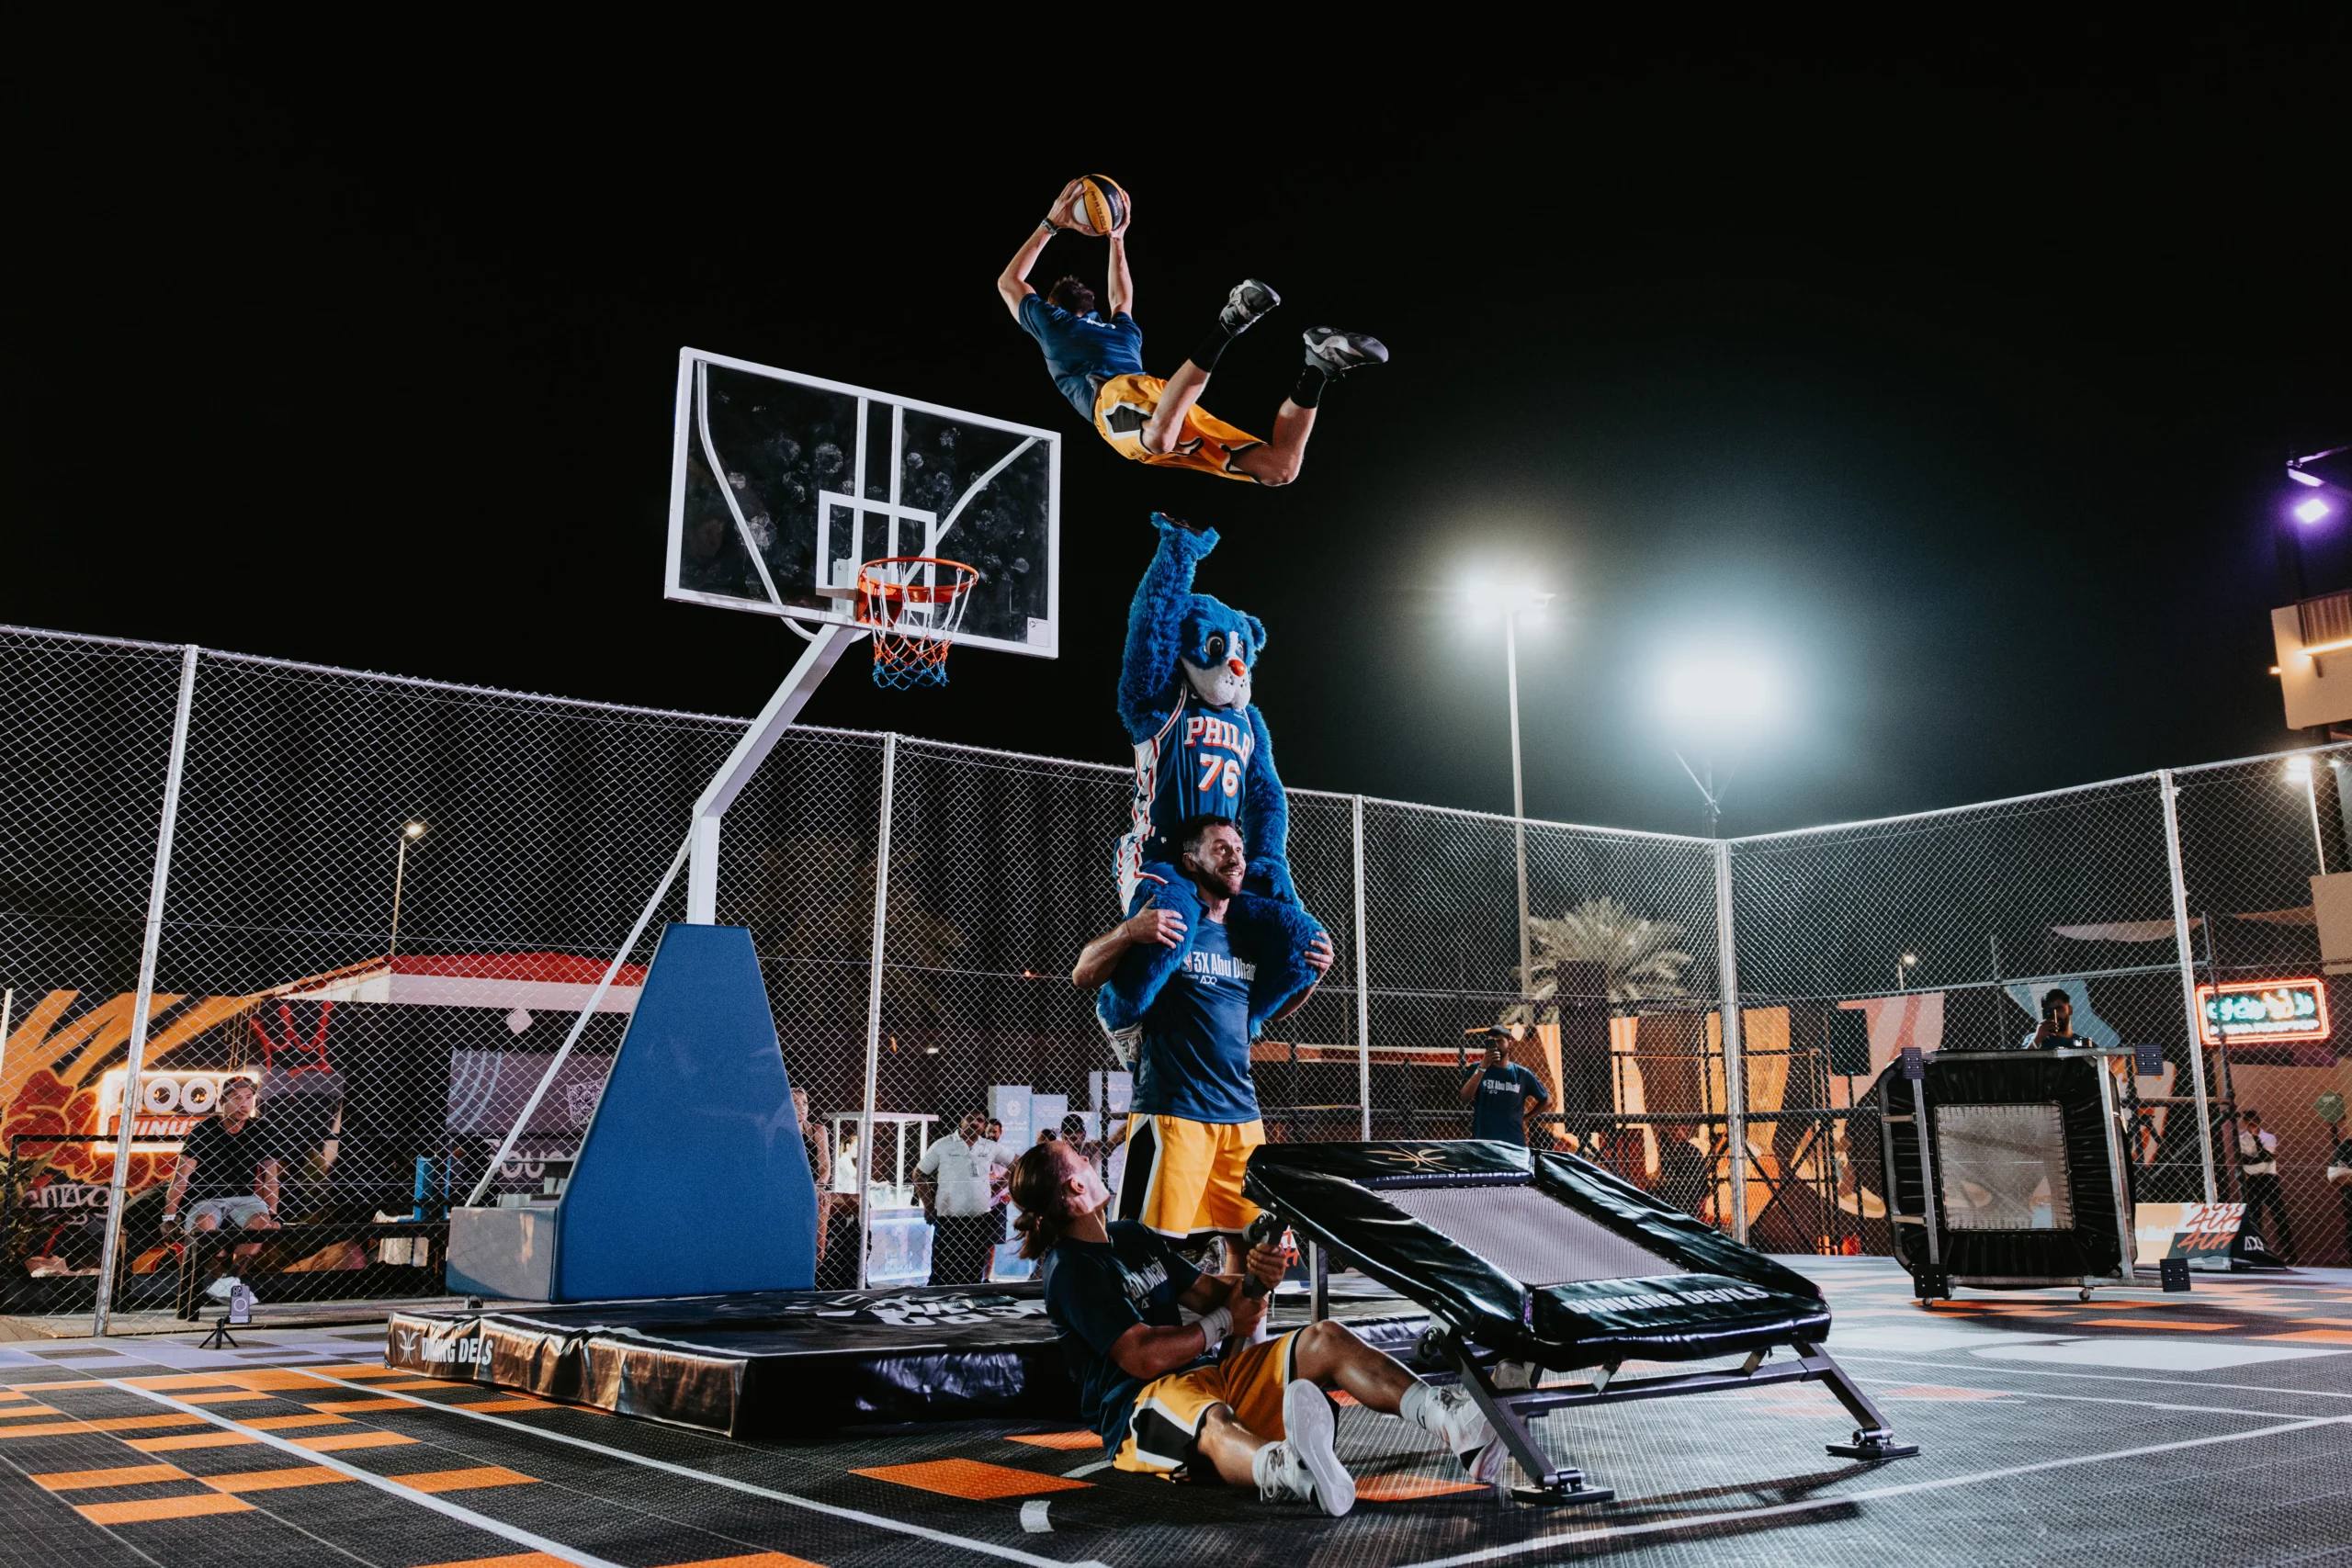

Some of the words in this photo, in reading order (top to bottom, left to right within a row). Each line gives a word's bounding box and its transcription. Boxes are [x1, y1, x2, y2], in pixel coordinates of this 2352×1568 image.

[1183, 716, 1250, 769] PHILA
[1198, 753, 1241, 797] 76
[1193, 952, 1210, 974] 3X
[1211, 953, 1231, 978] Abu
[1200, 975, 1217, 986] ADQ
[1561, 1292, 1686, 1314] DUNKING
[1677, 1286, 1770, 1305] DEVILS
